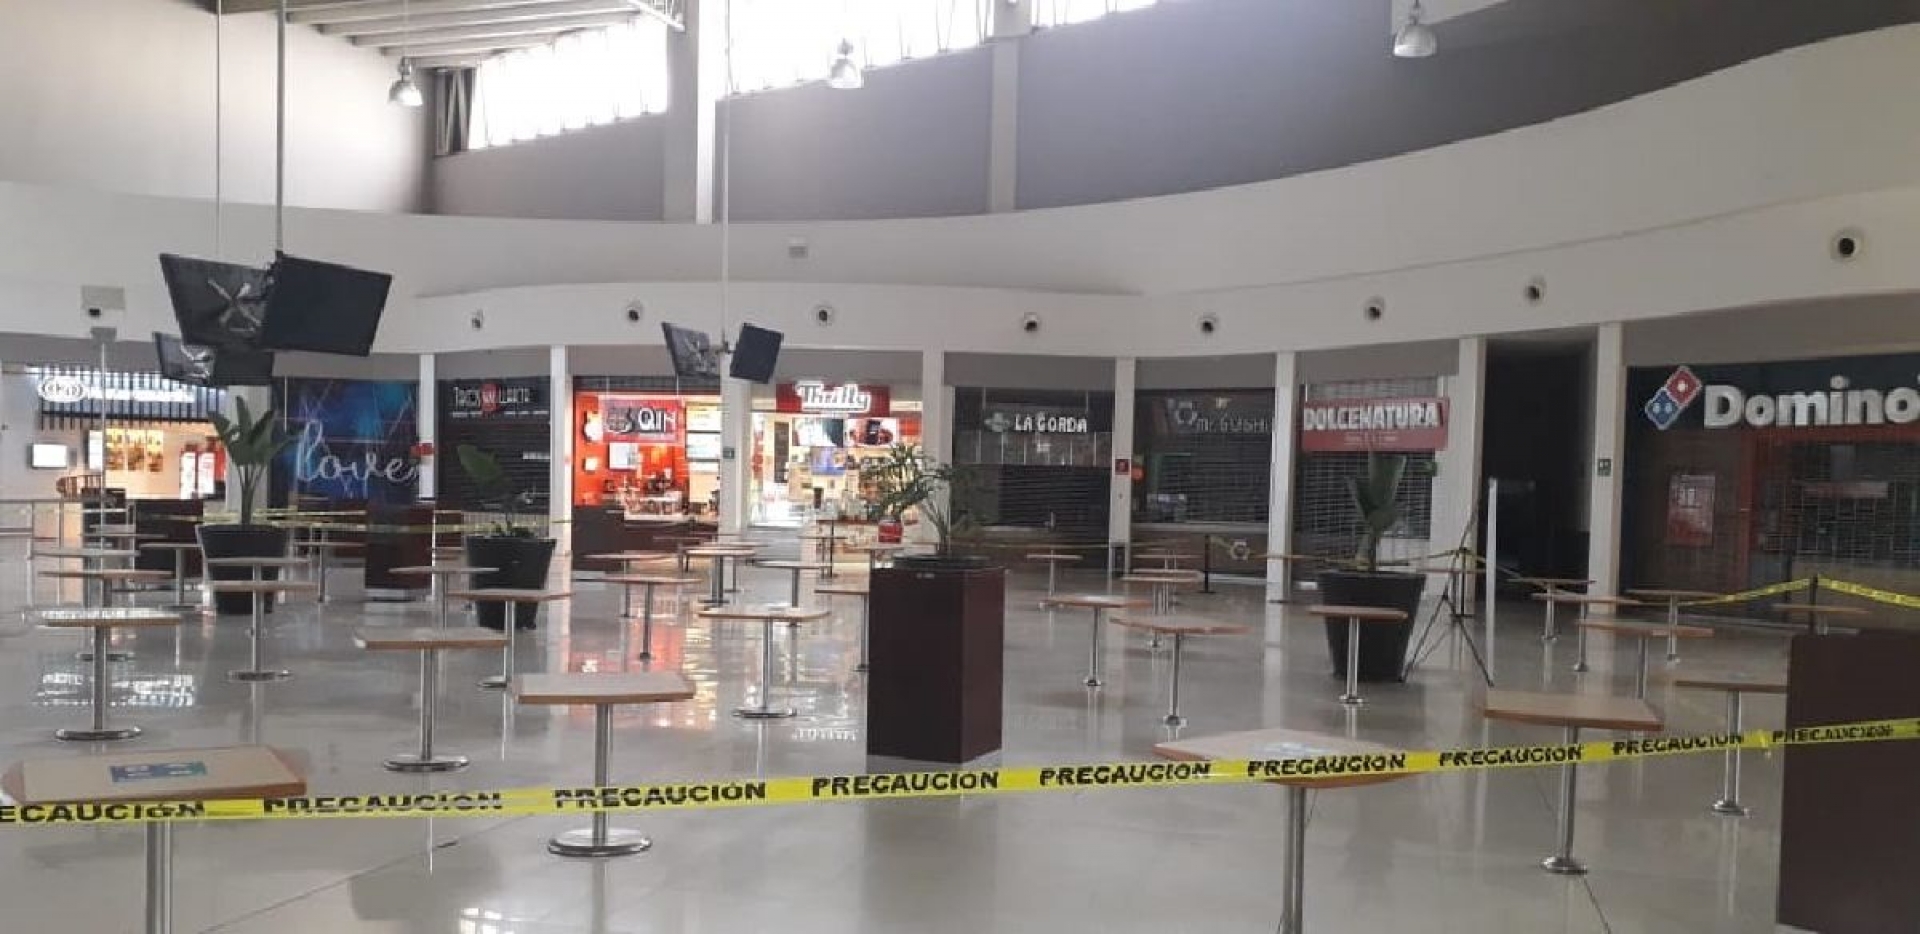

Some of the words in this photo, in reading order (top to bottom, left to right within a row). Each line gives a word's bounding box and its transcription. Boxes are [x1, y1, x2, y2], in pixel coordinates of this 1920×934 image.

[1703, 374, 1920, 429] Domino
[1015, 413, 1033, 431] LA
[1036, 411, 1088, 433] GORDA
[1303, 402, 1438, 430] DOLCENATURA
[296, 419, 419, 499] love
[554, 782, 766, 808] PRECAUCIÓN
